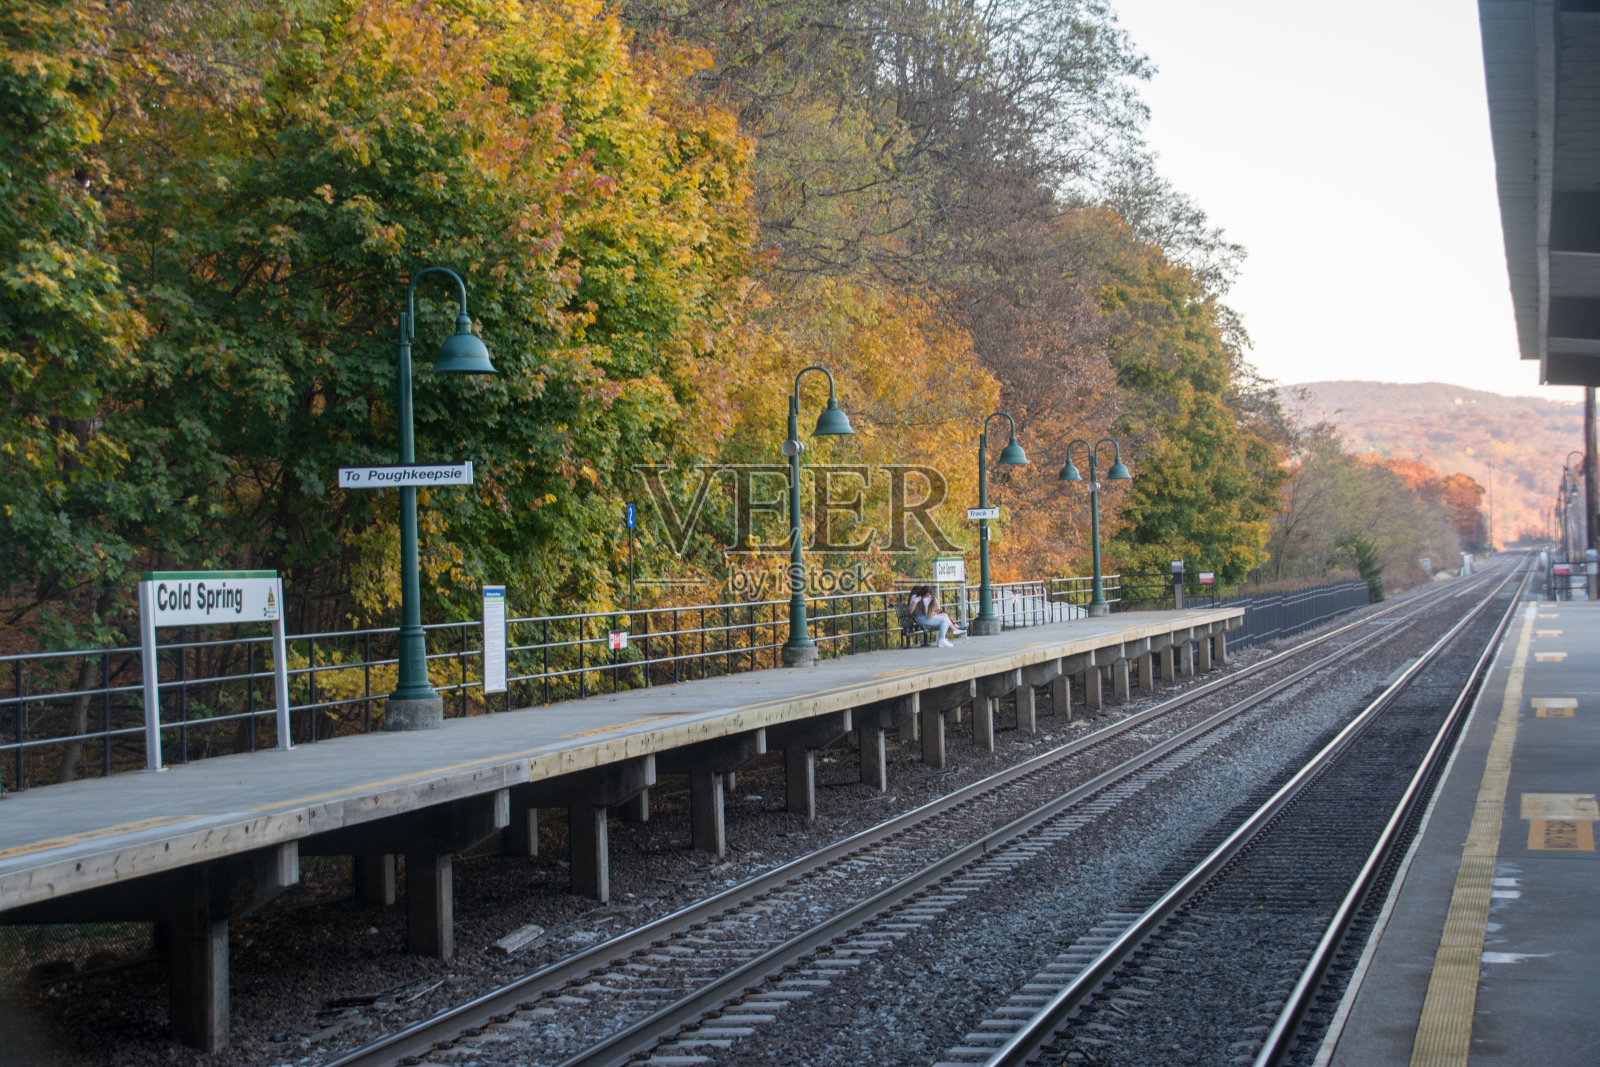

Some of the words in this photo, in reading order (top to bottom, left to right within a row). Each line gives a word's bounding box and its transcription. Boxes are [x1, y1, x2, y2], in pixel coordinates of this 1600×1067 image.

[345, 470, 360, 482] To
[368, 468, 462, 482] Poughkeepsie
[157, 583, 191, 611] Cold
[197, 582, 243, 615] Spring
